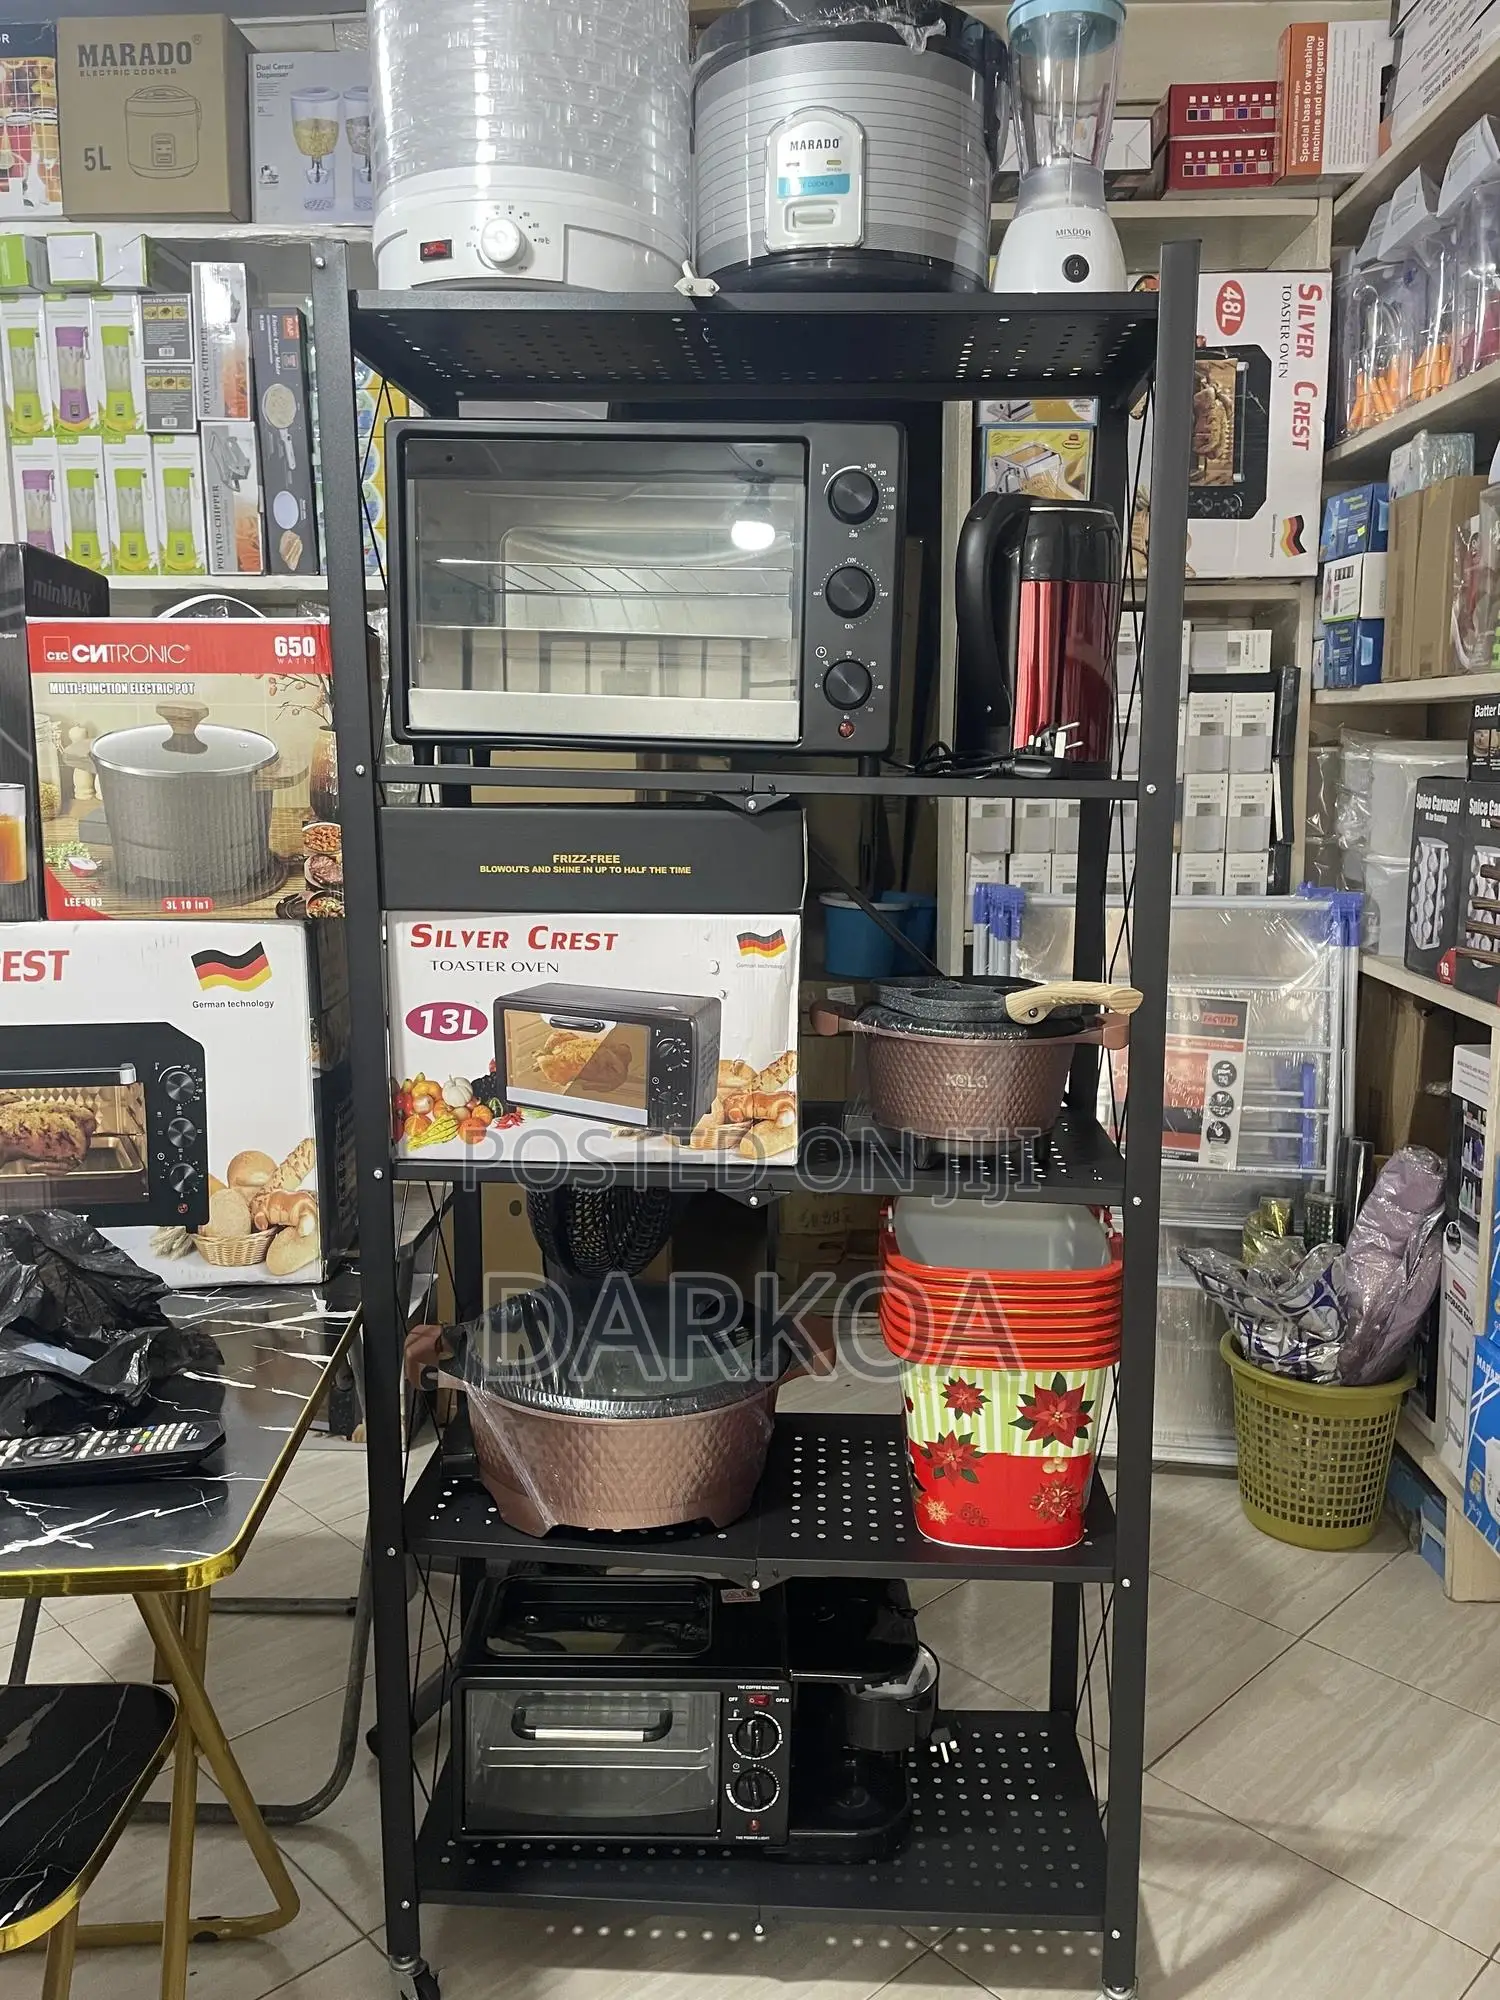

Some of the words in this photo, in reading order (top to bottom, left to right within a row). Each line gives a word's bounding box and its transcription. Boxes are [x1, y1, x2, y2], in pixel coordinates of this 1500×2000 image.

[77, 41, 193, 68] MARADO
[1304, 35, 1315, 77] washing
[1316, 36, 1325, 95] refrigerator
[79, 68, 131, 77] ELECTRIC
[133, 67, 178, 76] COOKER
[1303, 80, 1312, 95] for
[1302, 97, 1311, 122] base
[1314, 97, 1322, 116] and
[790, 138, 840, 151] MARADO
[1300, 123, 1310, 162] Special
[1312, 119, 1321, 162] machine
[84, 145, 112, 172] 5L
[1221, 286, 1242, 328] 48L
[1279, 284, 1292, 340] TOASTER
[1296, 283, 1323, 359] SILVER
[1278, 345, 1290, 379] OVEN
[1291, 381, 1318, 451] CREST
[211, 484, 225, 570] POTATO-CHIPPER
[33, 579, 92, 614] minMAX
[273, 635, 316, 658] 650
[277, 656, 316, 664] WATTS
[49, 682, 129, 695] MULTI-FUNCTION
[130, 682, 173, 695] ELECTRIC
[174, 682, 195, 695] POT
[1474, 704, 1497, 717] Batter
[1416, 792, 1432, 810] Spice
[1431, 794, 1461, 814] Carousel
[1468, 797, 1488, 816] Spice
[479, 865, 530, 873] BLOWOUTS
[531, 865, 551, 873] AND
[552, 865, 581, 873] SHINE
[595, 866, 607, 874] UP
[609, 866, 622, 874] TO
[624, 866, 647, 874] HALF
[649, 866, 667, 874] THE
[668, 866, 692, 875] TIME
[552, 854, 621, 864] FRIZZ-FREE
[166, 900, 177, 910] 3L
[181, 900, 192, 910] 10
[410, 923, 510, 949] SILVER
[527, 925, 619, 951] CREST
[0, 950, 70, 983] EST
[430, 959, 507, 973] TOASTER
[511, 960, 560, 974] OVEN
[1440, 962, 1449, 976] 16
[192, 1000, 226, 1009] German
[227, 999, 275, 1010] technology
[418, 1008, 479, 1037] 13L
